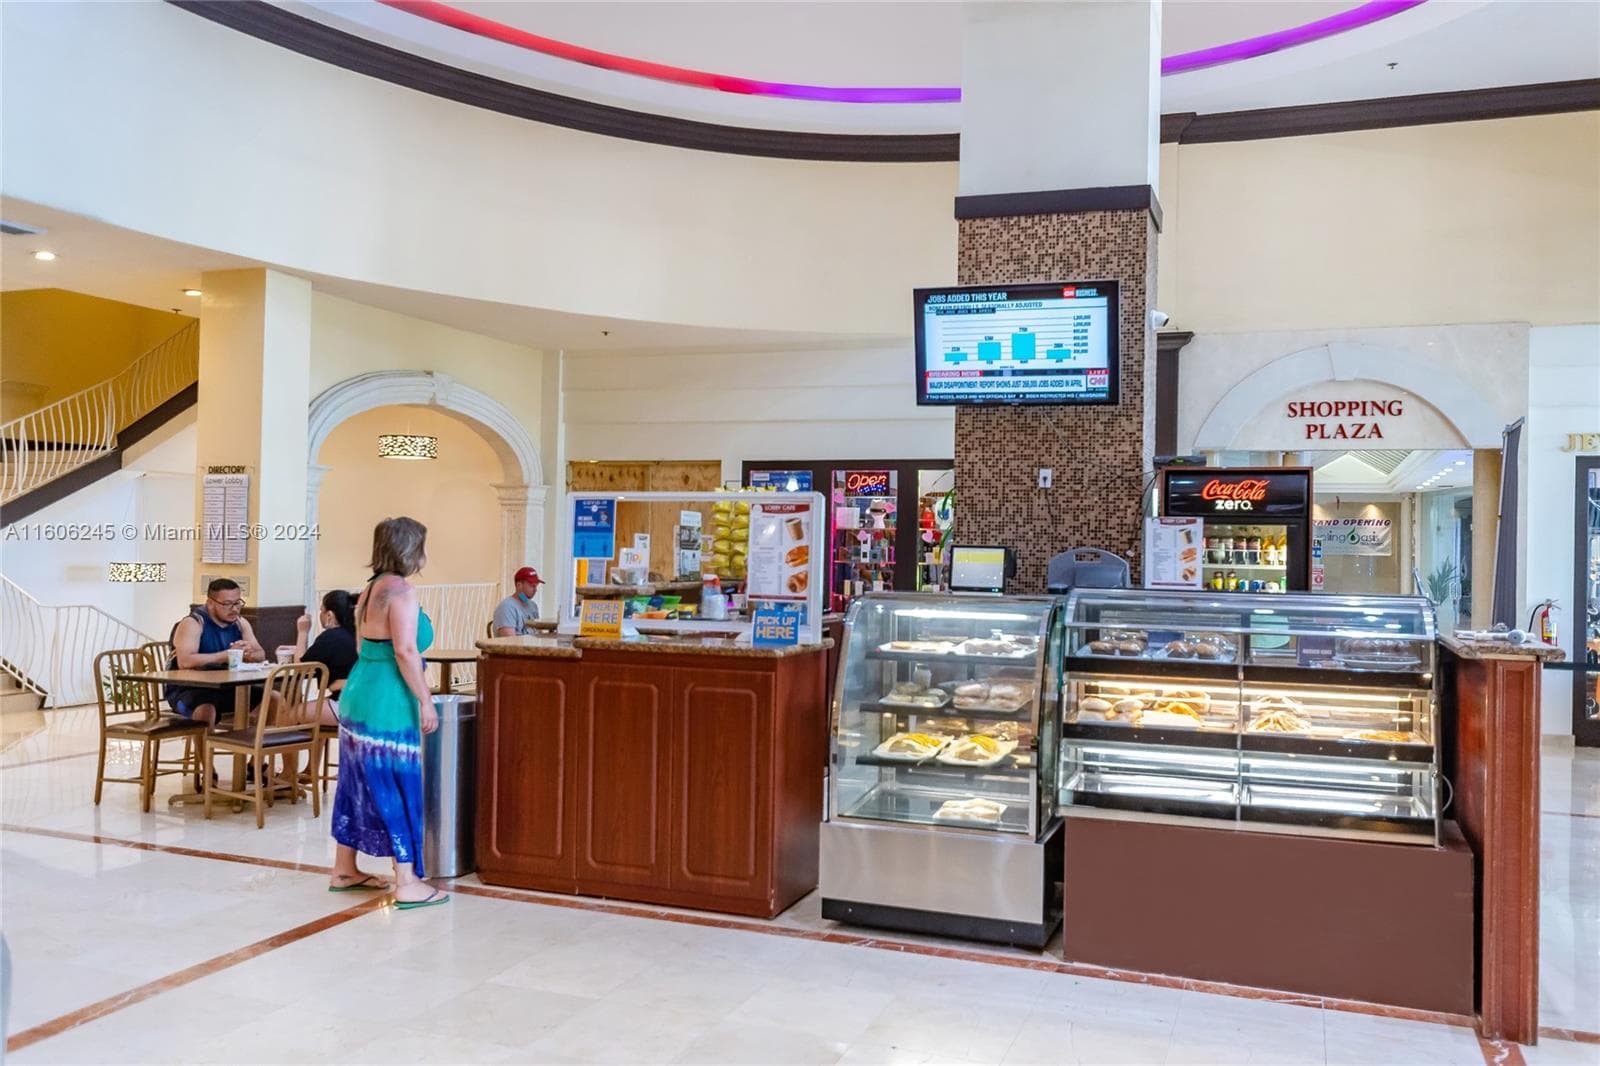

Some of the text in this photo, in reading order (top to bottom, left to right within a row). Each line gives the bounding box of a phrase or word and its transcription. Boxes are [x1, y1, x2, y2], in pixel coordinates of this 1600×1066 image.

[928, 292, 1008, 304] JOBS ADDED THIS YEAR
[980, 381, 995, 389] REPORT
[1089, 378, 1106, 386] CNN
[1287, 400, 1403, 418] SHOPPING
[1306, 423, 1384, 439] PLAZA
[1558, 432, 1600, 453] JE
[208, 466, 246, 474] DIRECTORY
[224, 477, 243, 486] Lobby
[847, 474, 887, 492] Open
[1202, 479, 1271, 500] Coca-Cola
[584, 612, 618, 624] HERE
[757, 616, 796, 626] PICK UP
[756, 626, 795, 640] HERE
